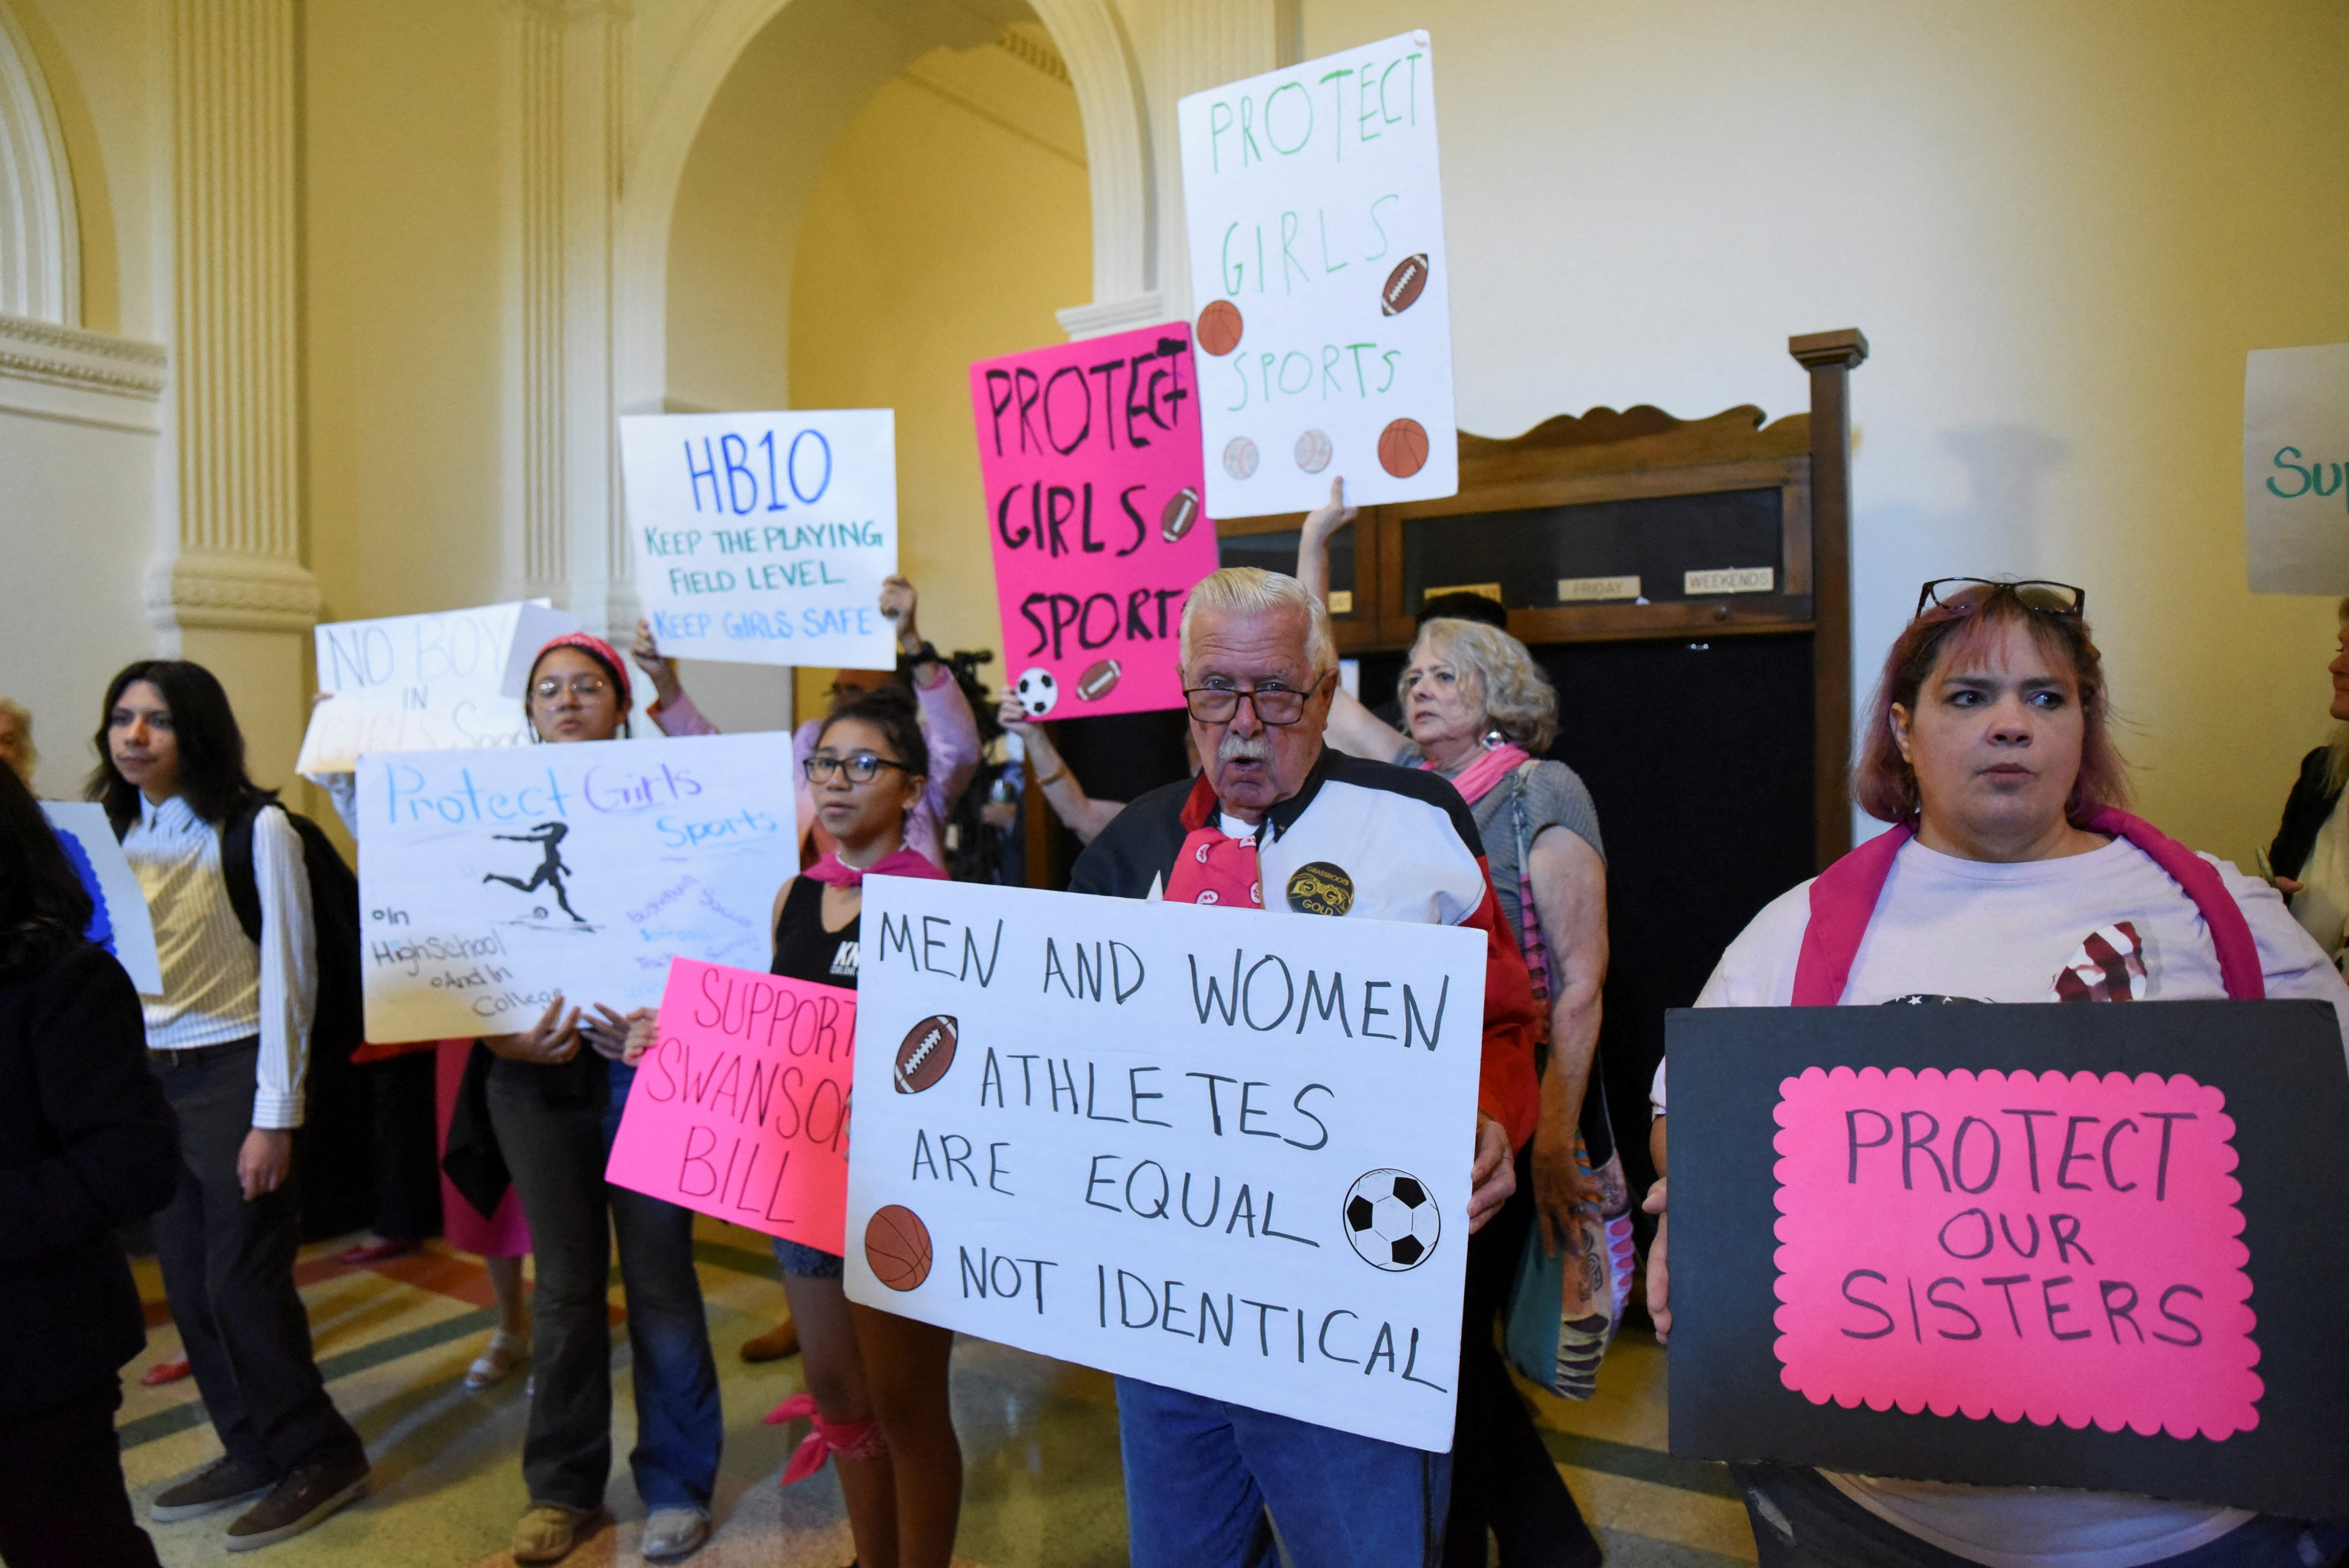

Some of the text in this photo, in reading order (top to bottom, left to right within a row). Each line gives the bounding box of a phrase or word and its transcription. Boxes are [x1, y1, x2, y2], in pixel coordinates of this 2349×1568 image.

[1210, 53, 1424, 174] PROTECT
[1221, 193, 1400, 297] GIRLS
[985, 337, 1187, 456] PROTECT
[1227, 343, 1402, 412] SPORTS
[684, 429, 833, 516] HB10
[2266, 446, 2349, 514] Su
[644, 520, 884, 556] KEEP THE PLAYING
[998, 480, 1148, 558] GIRLS
[669, 560, 848, 596] FIELD LEVEL
[1573, 571, 1770, 594] FRIDAY WEEKENDS
[326, 625, 395, 691] NO
[653, 606, 873, 640] KEEP GIRLS SAFE
[1020, 588, 1186, 660] SPORT
[402, 685, 428, 711] IN
[385, 762, 703, 824] Protect Girls
[656, 809, 778, 850] Sports
[1303, 899, 1334, 916] GOLD
[1306, 866, 1350, 886] GRASSROOTS
[879, 910, 1450, 1052] MEN AND WOMEN
[980, 1045, 1336, 1152] ATHLETES
[679, 1125, 795, 1224] BILL
[911, 1128, 1321, 1249] ARE EQUAL
[1844, 1108, 2199, 1202] PROTECT
[1937, 1206, 2096, 1266] OUR
[958, 1245, 1449, 1395] NOT IDENTICAL
[1839, 1268, 2204, 1348] SISTERS
